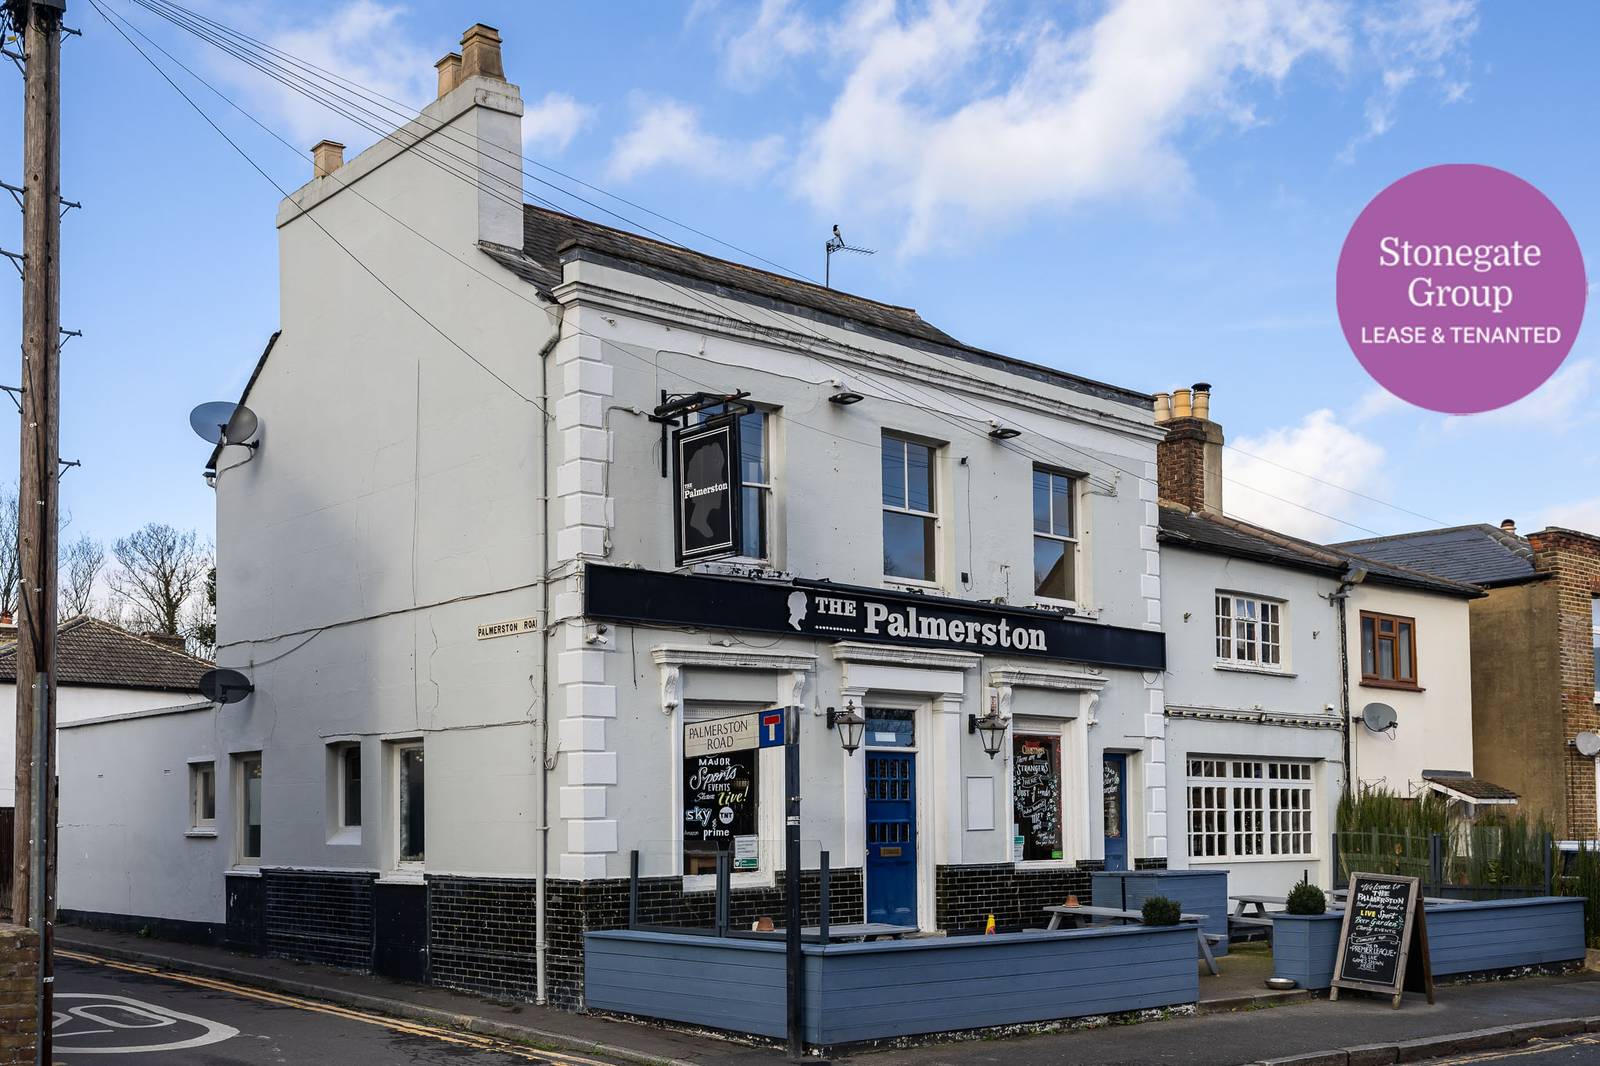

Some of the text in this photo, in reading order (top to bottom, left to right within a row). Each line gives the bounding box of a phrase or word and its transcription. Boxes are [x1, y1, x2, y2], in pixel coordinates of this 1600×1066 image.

[684, 482, 728, 499] Palmerston
[477, 619, 538, 637] PALMERSTON ROA
[815, 596, 1048, 652] THE Palmerston
[689, 719, 748, 740] PALMERSTON
[707, 735, 734, 750] ROAD
[698, 758, 731, 766] MAJOR
[690, 764, 744, 790] Sports
[707, 783, 731, 792] EVENTS
[686, 806, 712, 827] sky
[703, 828, 730, 841] prime
[1360, 883, 1391, 891] Welcome
[1357, 892, 1404, 904] PALMERSTON
[1355, 916, 1370, 924] Beer
[1360, 910, 1398, 920] LIVE Sport
[1351, 945, 1374, 954] PREMIER
